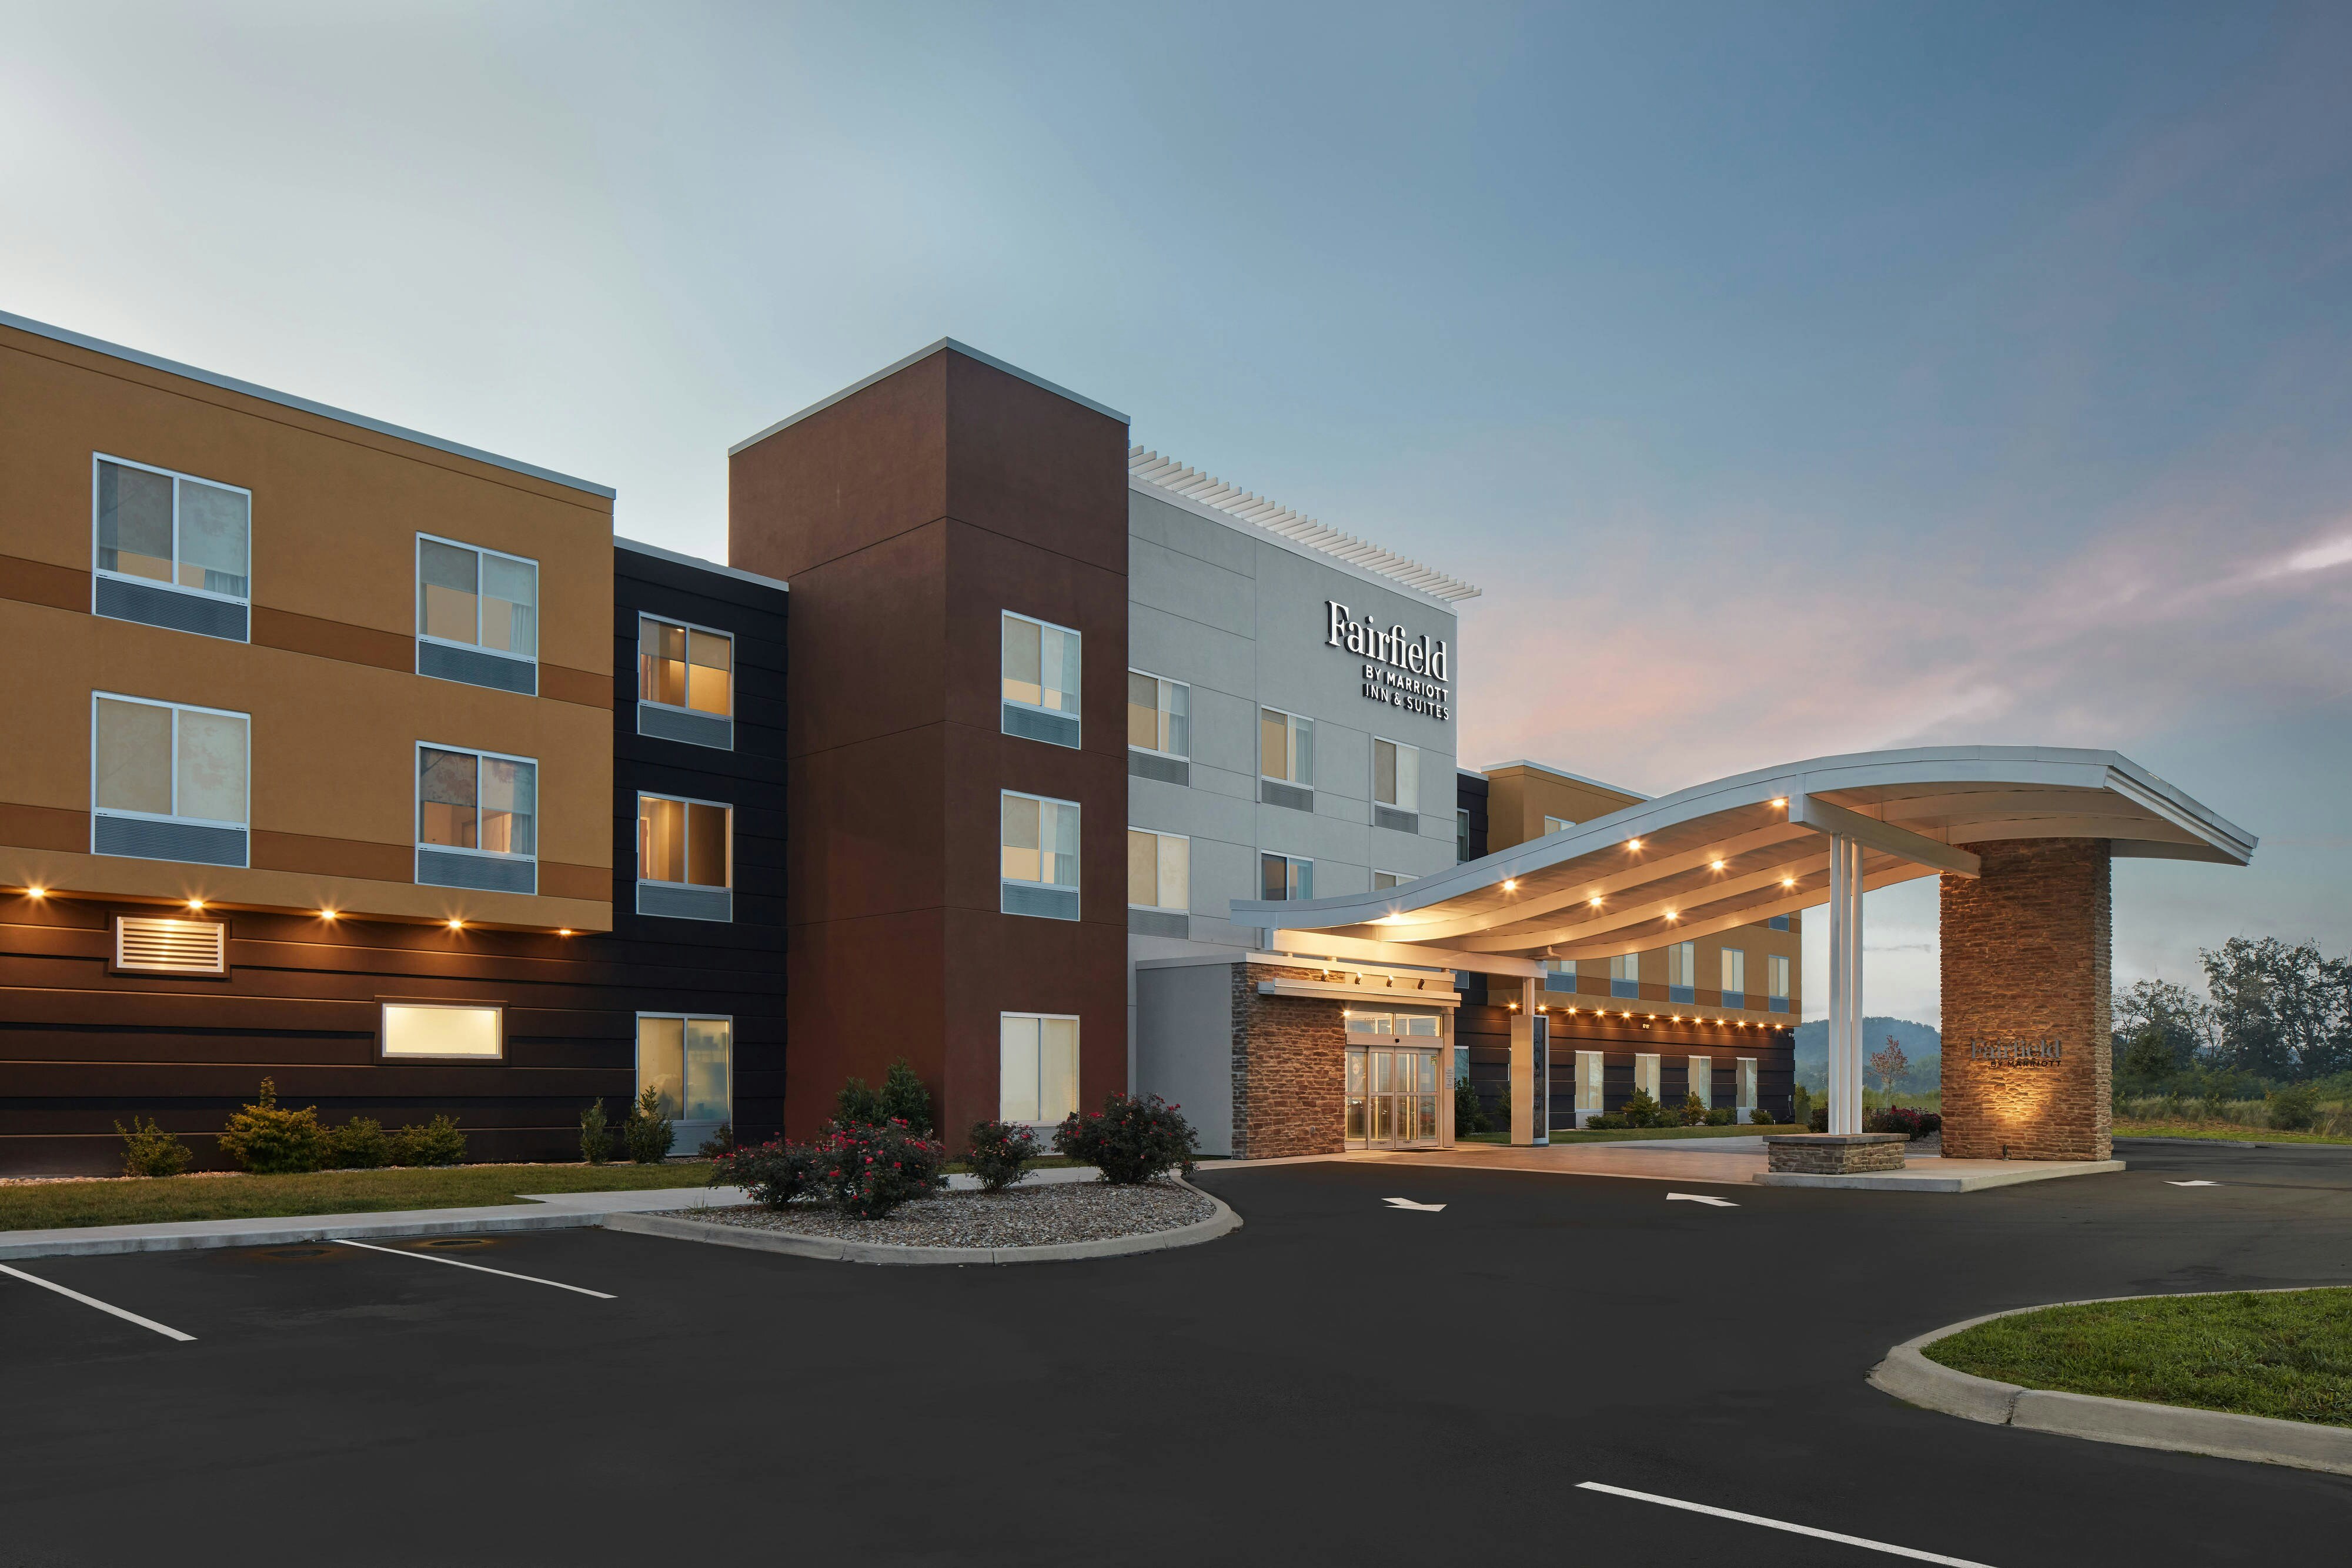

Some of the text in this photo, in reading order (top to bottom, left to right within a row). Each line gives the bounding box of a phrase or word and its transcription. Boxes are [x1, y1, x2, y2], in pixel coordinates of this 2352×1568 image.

[1325, 600, 1449, 682] Fairfield
[1363, 664, 1448, 702] BY MARRIOTT
[1363, 683, 1449, 720] INN & SUITES
[1970, 1038, 2062, 1059] Fairfield
